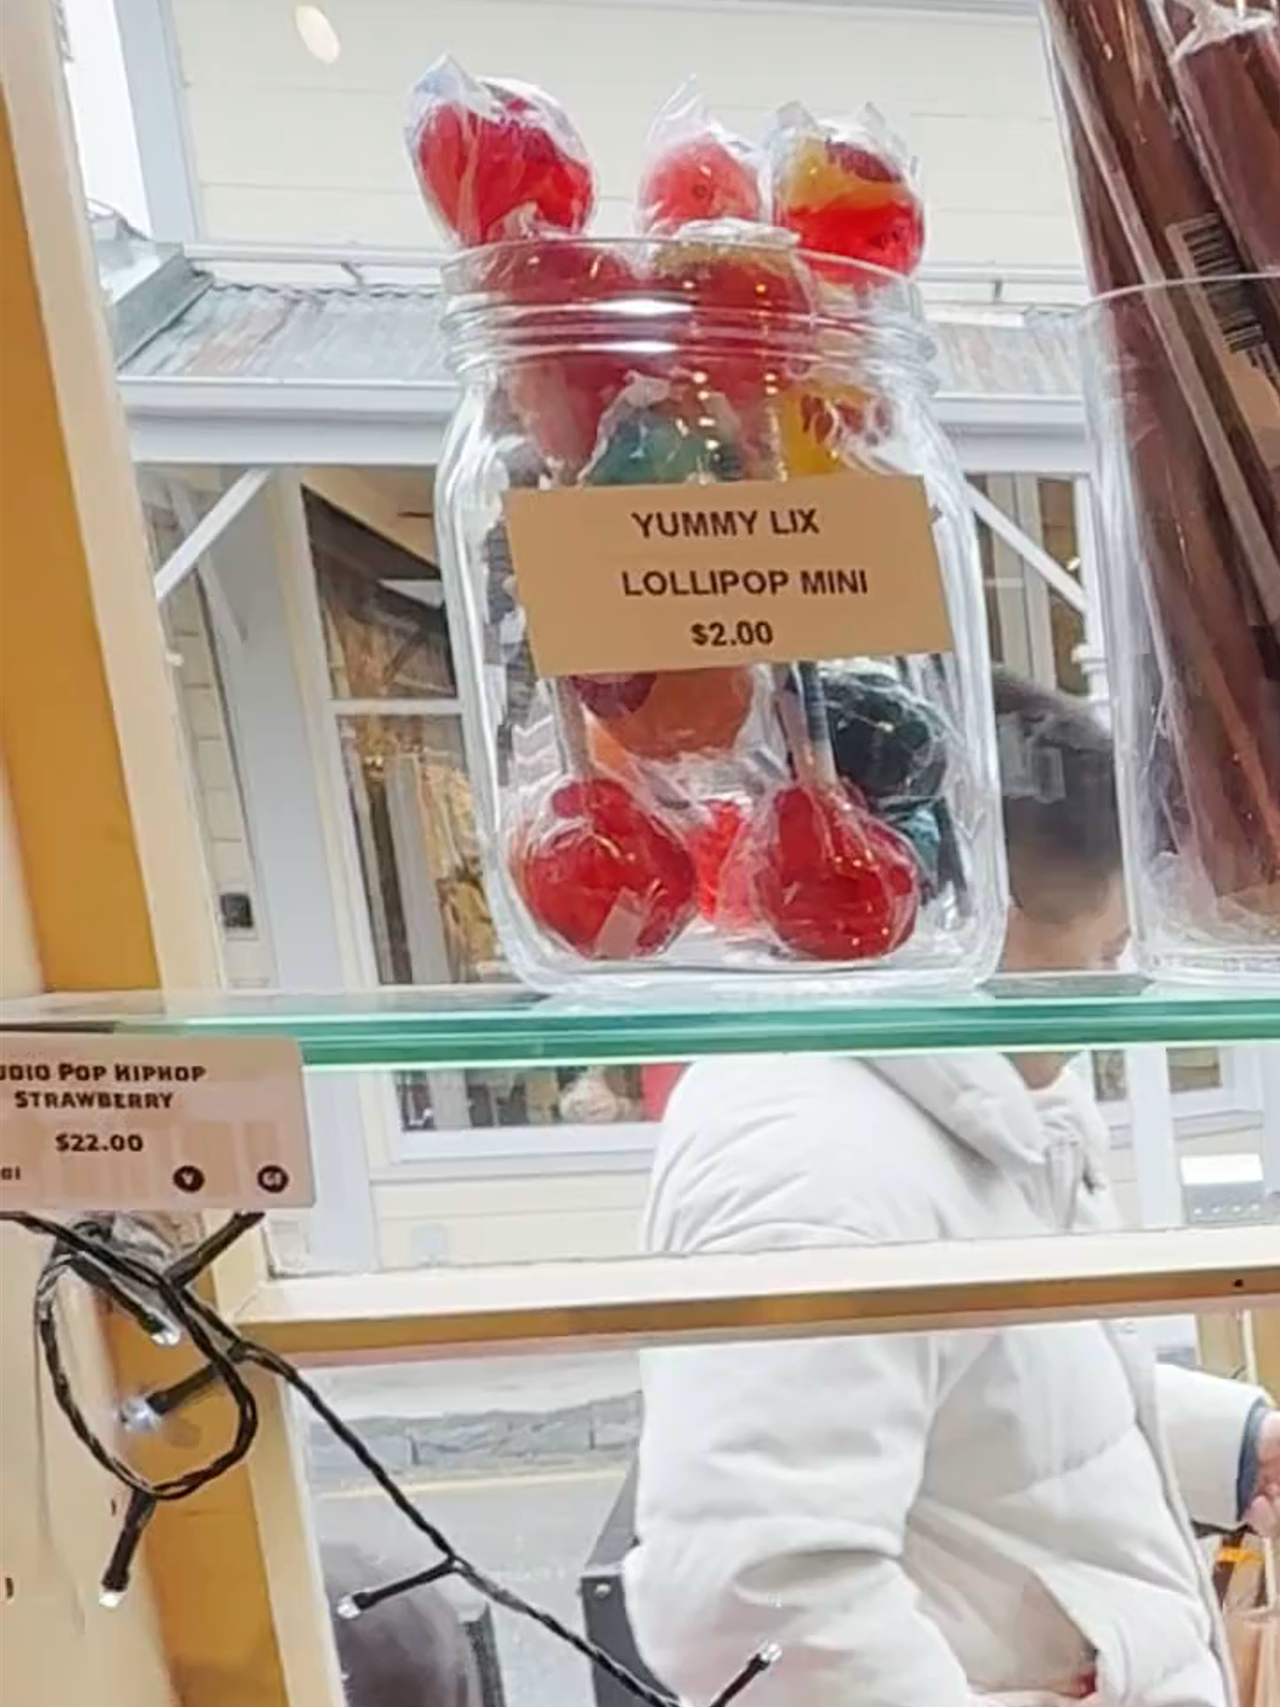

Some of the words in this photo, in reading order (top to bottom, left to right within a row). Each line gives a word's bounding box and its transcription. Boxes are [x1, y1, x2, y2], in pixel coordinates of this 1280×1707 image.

[632, 509, 758, 539] YUMMY
[770, 508, 820, 535] LIX
[621, 570, 789, 597] LOLLIPOP
[800, 569, 868, 595] MINI
[691, 621, 773, 647] $2.00
[58, 1063, 107, 1081] POP
[114, 1064, 206, 1082] HIPHOP
[14, 1091, 174, 1109] STRAWBERRY
[55, 1133, 144, 1152] $22.00
